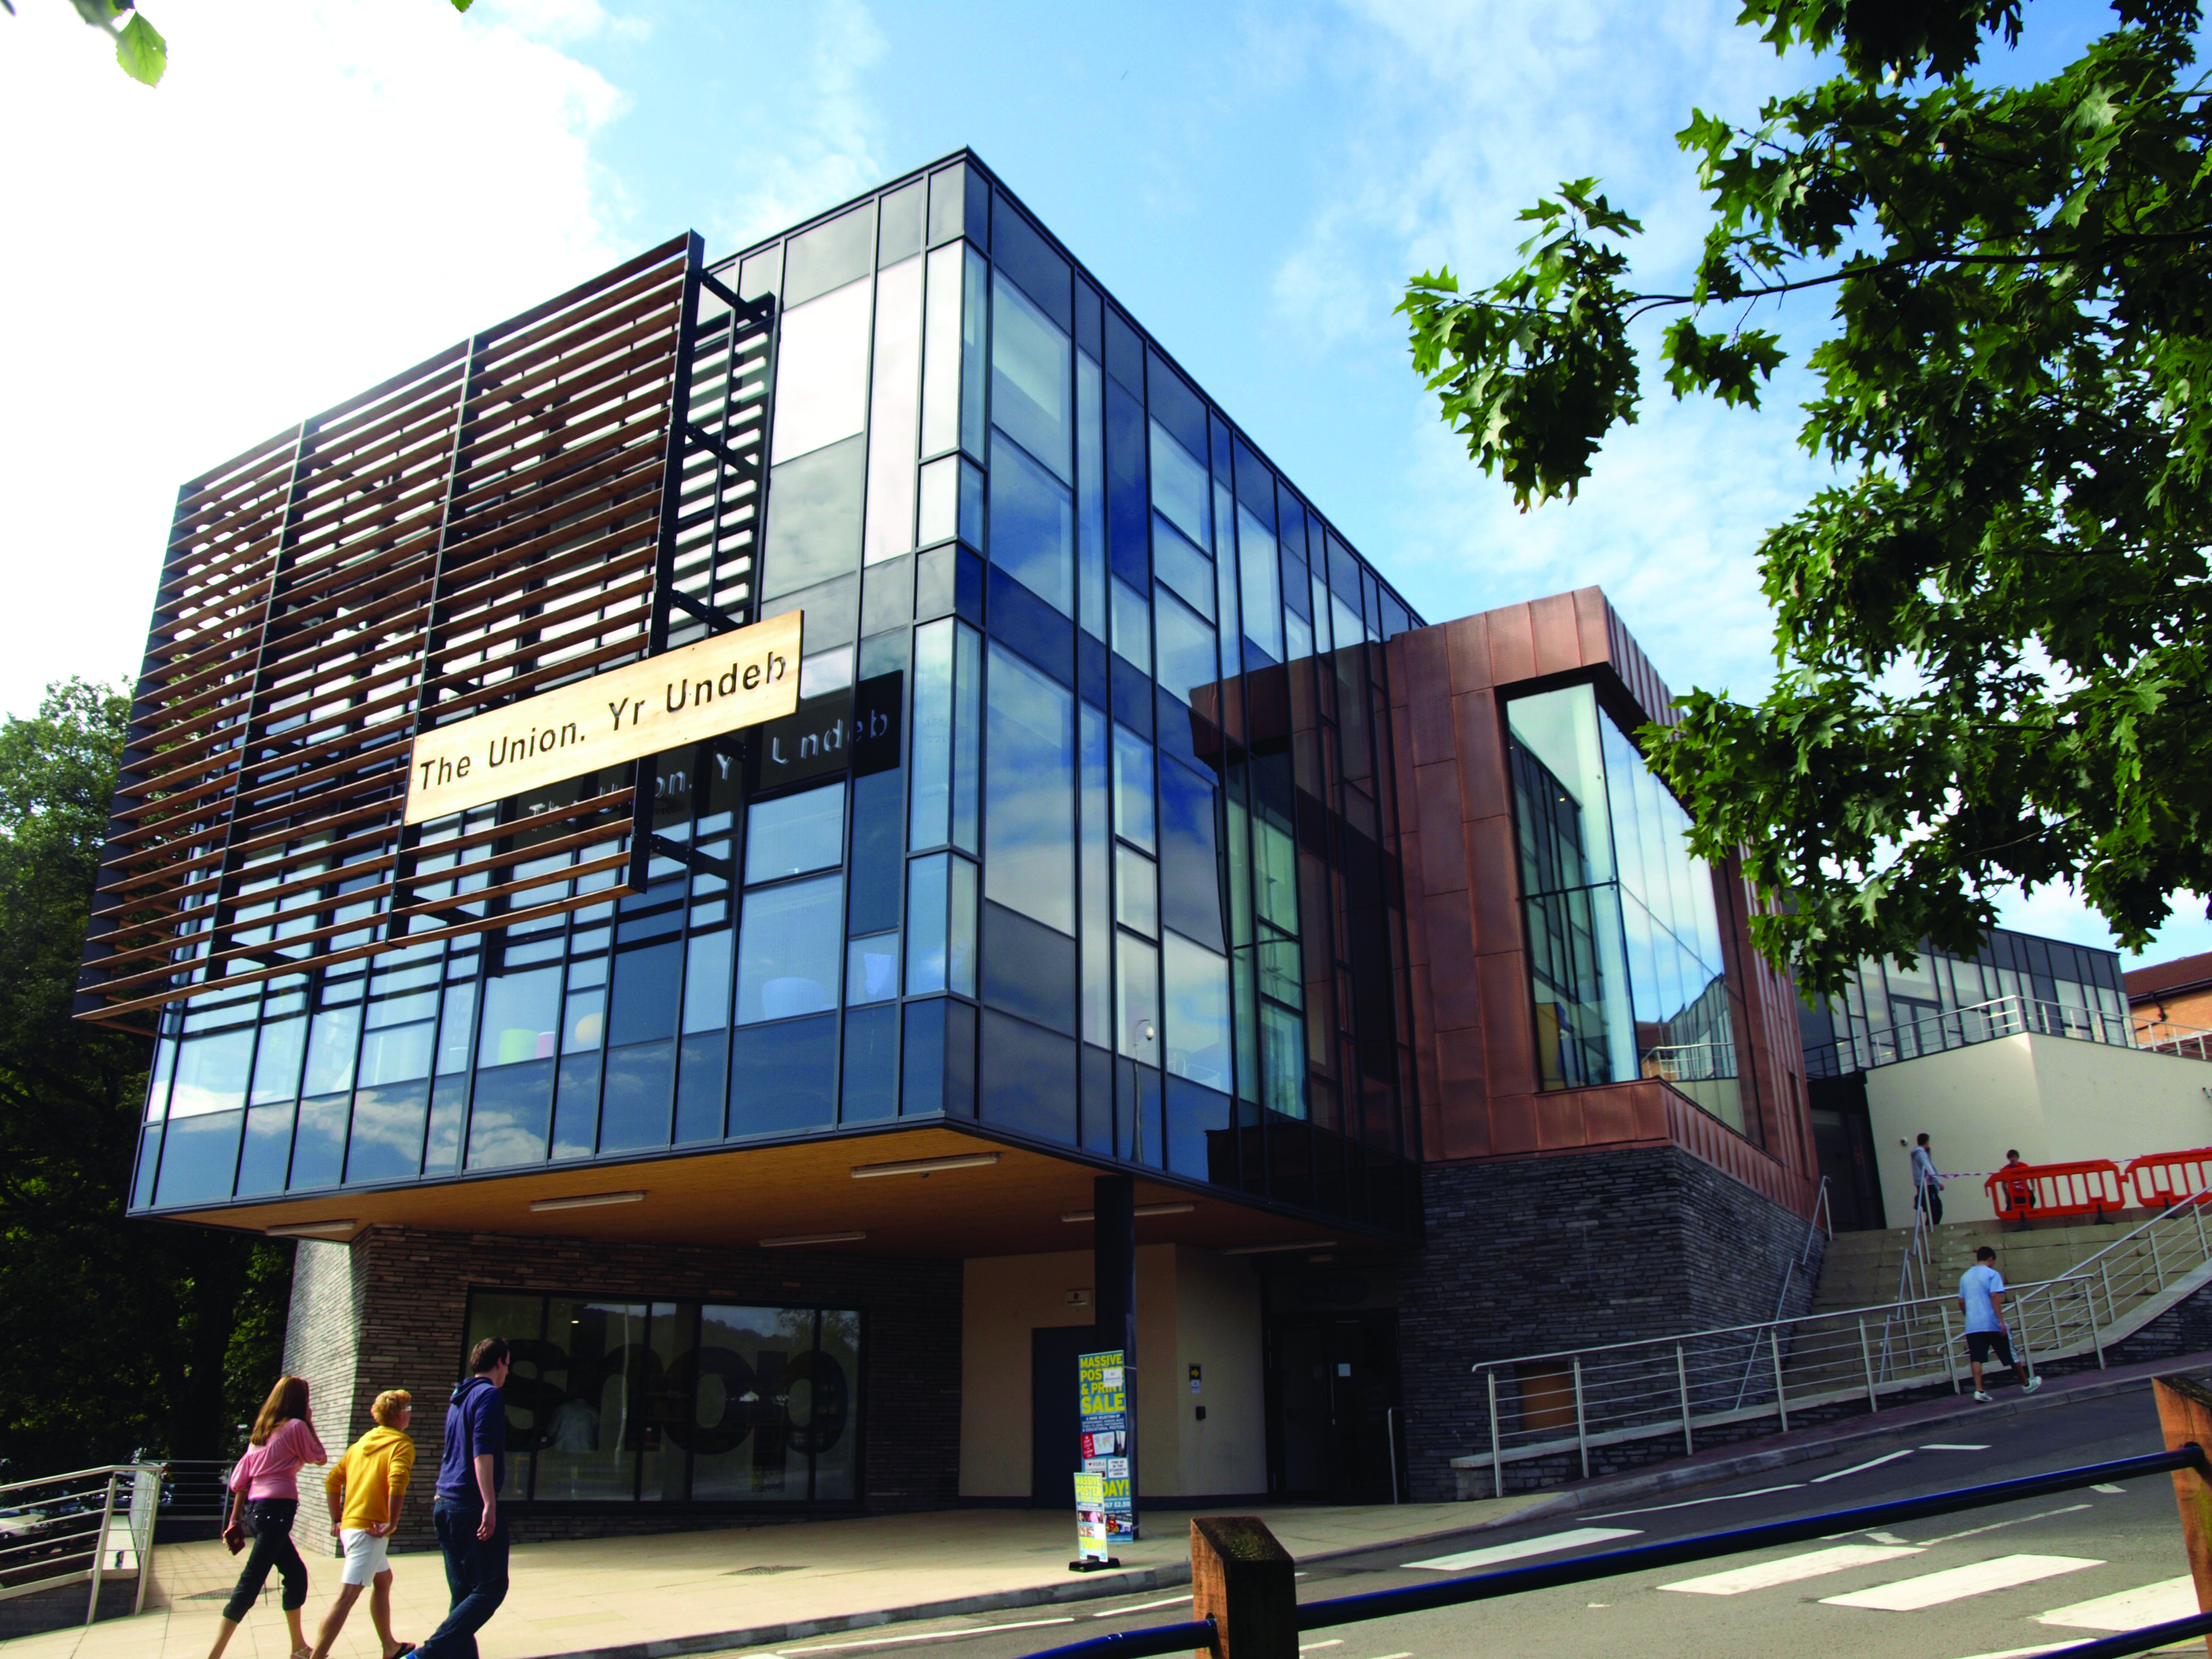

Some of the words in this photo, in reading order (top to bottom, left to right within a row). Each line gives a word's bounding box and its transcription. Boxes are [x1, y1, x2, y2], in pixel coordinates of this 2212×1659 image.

[420, 756, 471, 792] The
[488, 722, 586, 768] Union.
[608, 696, 646, 731] Yr
[666, 652, 786, 714] Undeb
[1080, 1354, 1123, 1368] MASSIVE
[1080, 1366, 1124, 1382] POS
[1081, 1383, 1089, 1395] &
[1081, 1393, 1126, 1415] SALE
[1076, 1476, 1101, 1486] MASSIVE
[1103, 1479, 1130, 1497] DAY!
[1076, 1486, 1102, 1496] POSTER
[1079, 1537, 1106, 1551] TODAY!
